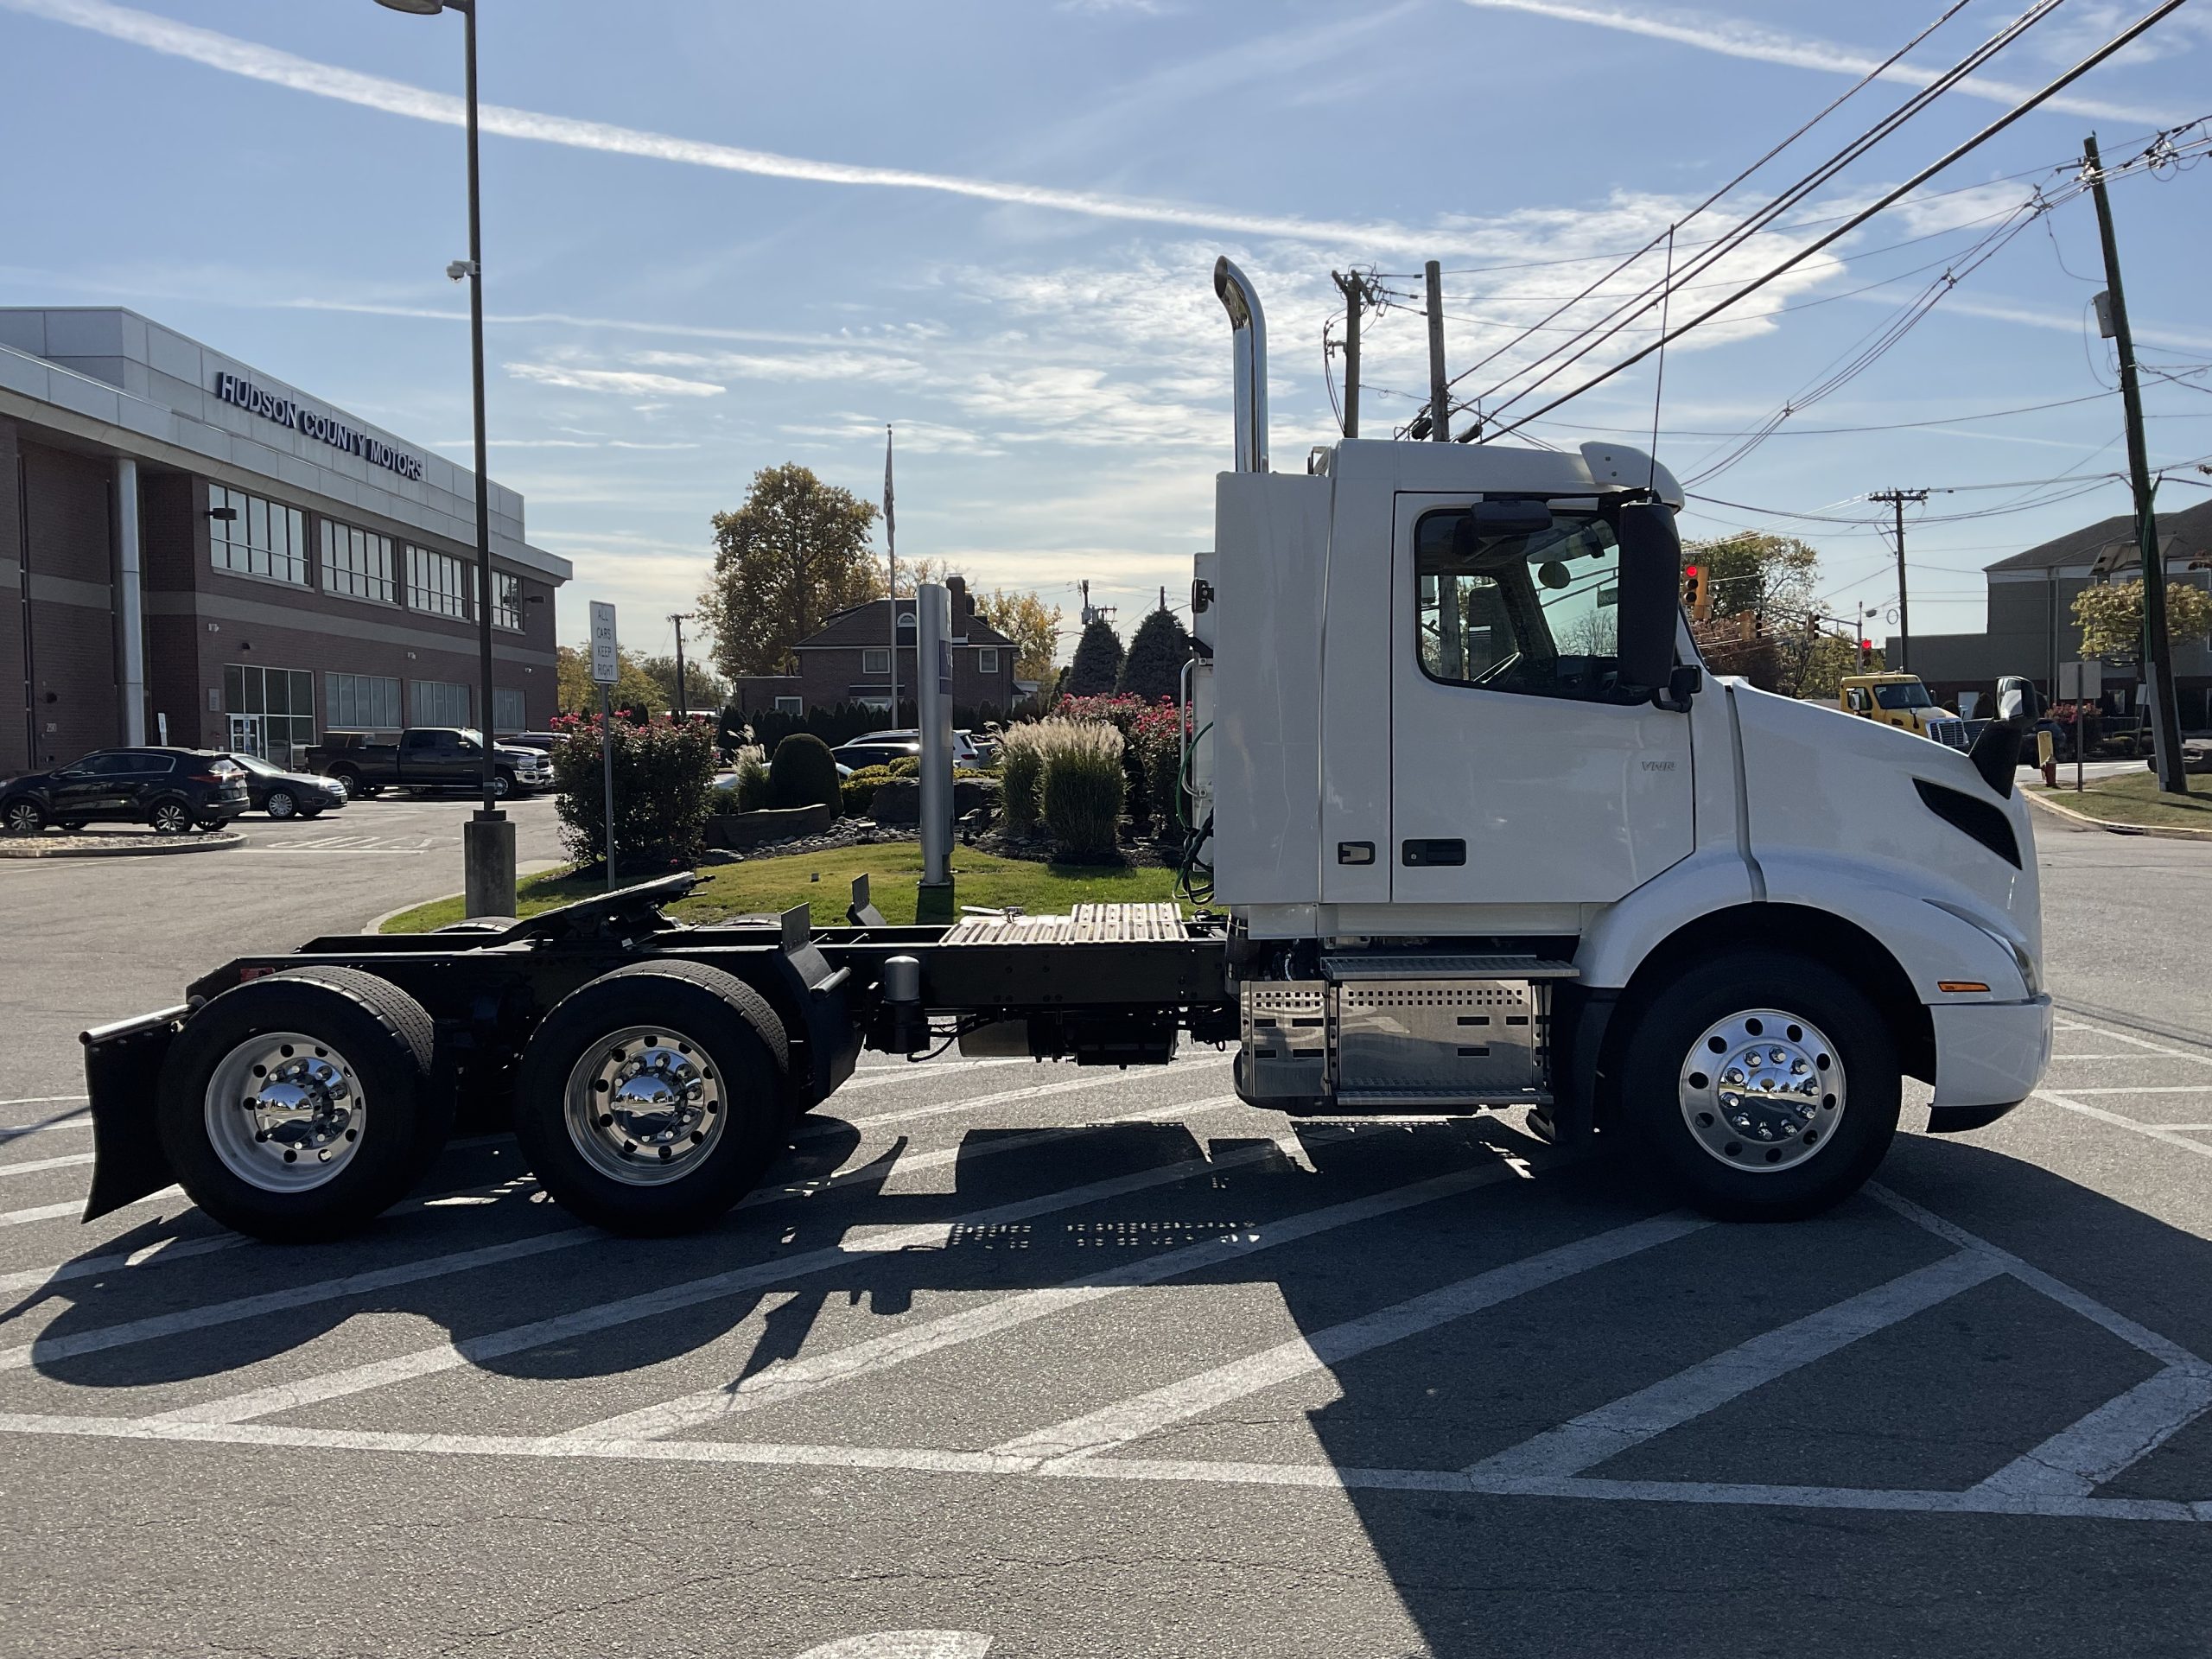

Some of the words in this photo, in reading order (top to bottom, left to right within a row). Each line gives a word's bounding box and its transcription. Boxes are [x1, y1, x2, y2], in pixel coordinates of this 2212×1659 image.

[217, 372, 298, 429] HUDSON
[301, 410, 367, 456] COUNTY
[368, 438, 423, 481] MOTORS
[598, 608, 608, 621] ALL
[597, 627, 611, 640] CARS
[597, 645, 611, 658] KEEP
[597, 663, 613, 676] RIGHT
[1642, 761, 1676, 772] VNR
